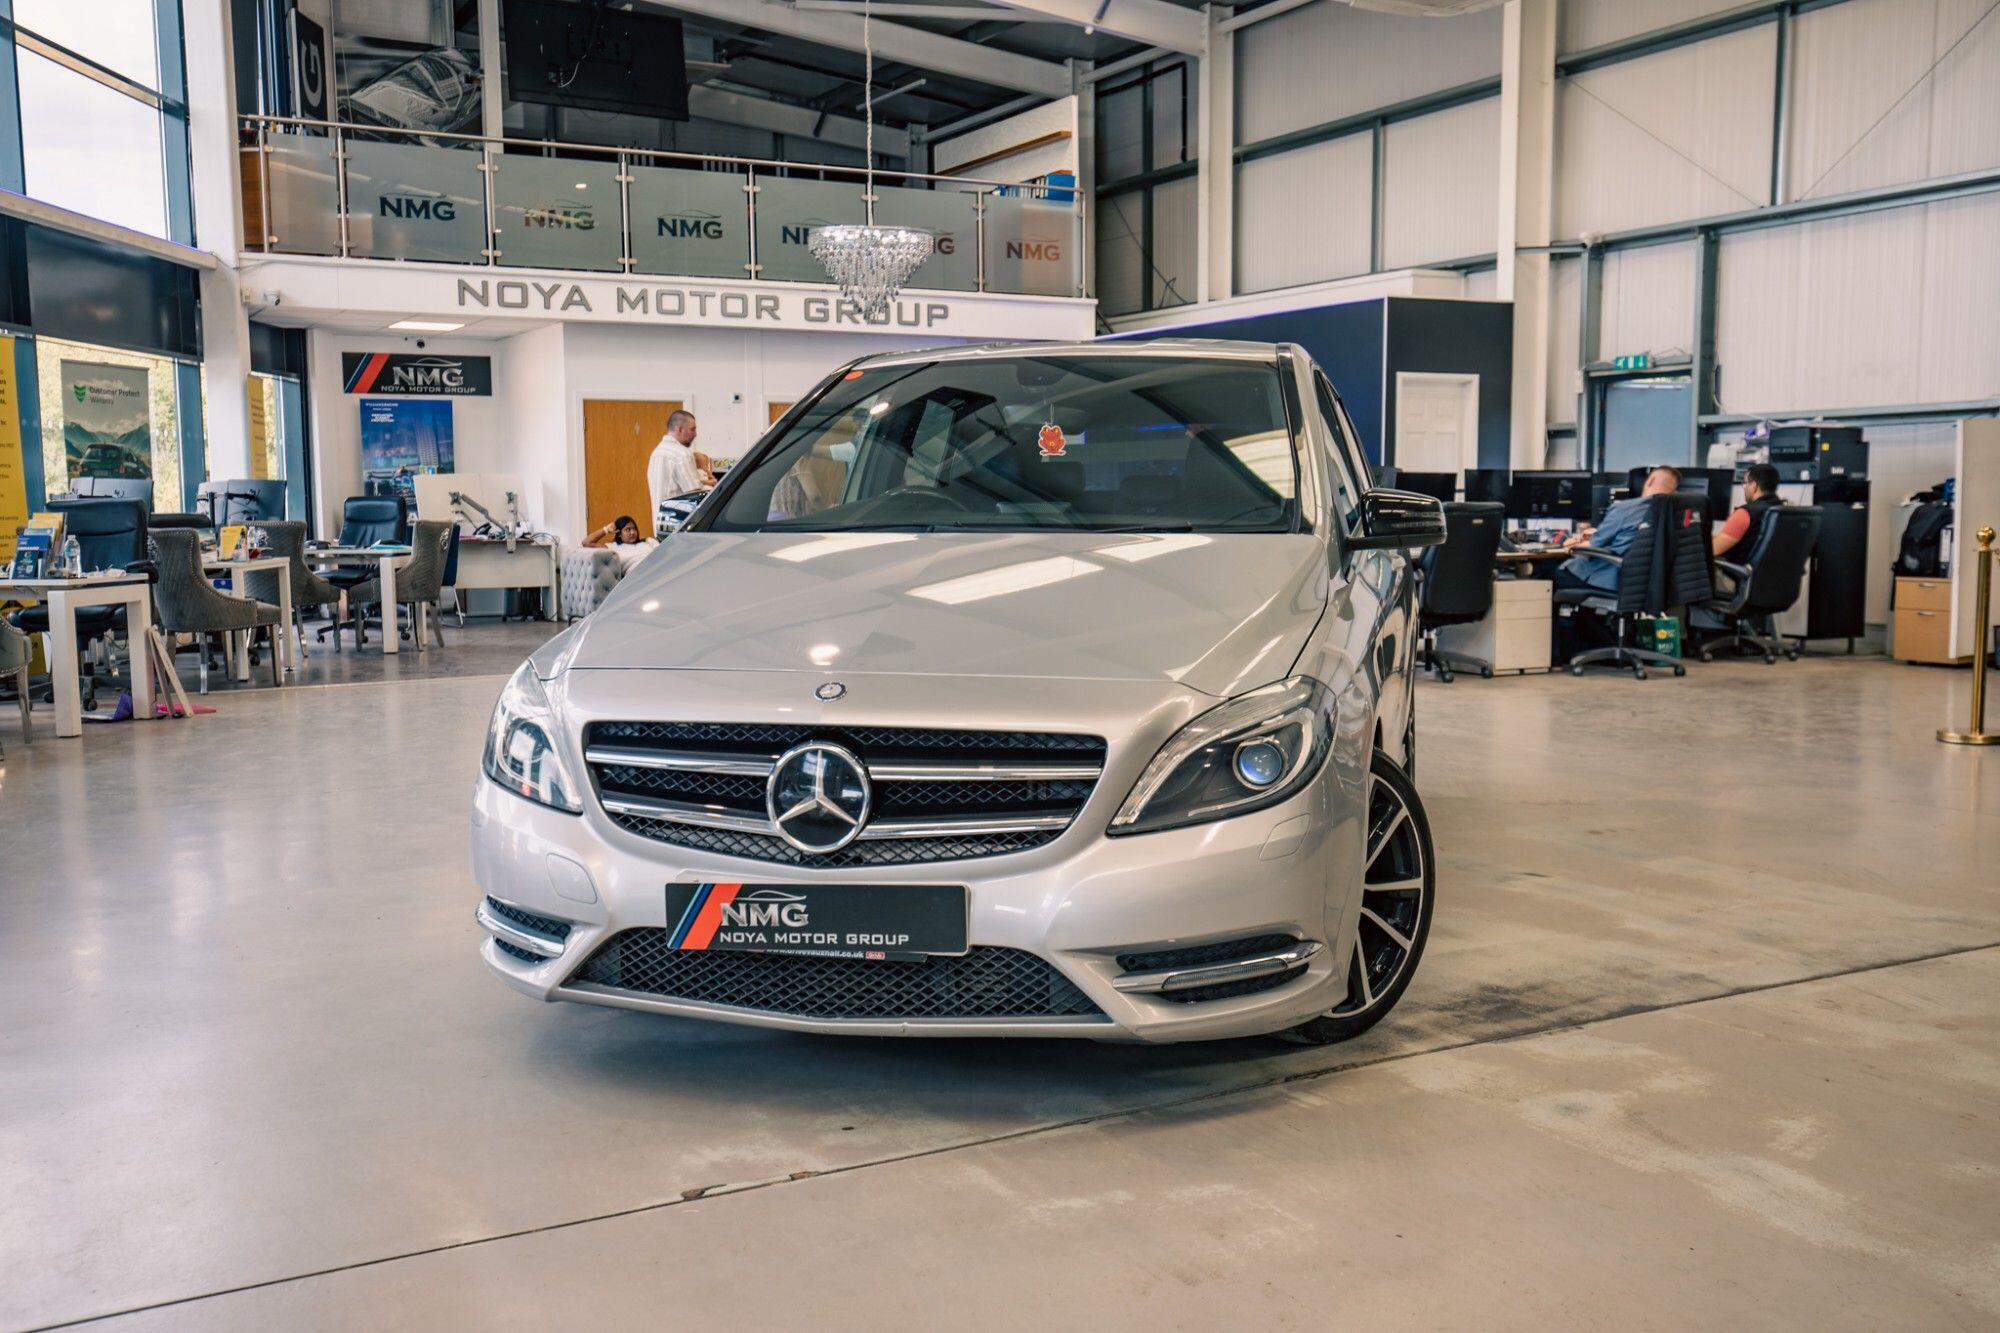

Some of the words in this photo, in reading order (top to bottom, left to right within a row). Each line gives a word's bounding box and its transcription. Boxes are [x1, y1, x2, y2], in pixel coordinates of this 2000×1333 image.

[379, 196, 456, 221] NMG
[524, 208, 595, 230] NMG
[657, 217, 723, 239] NMG
[1006, 241, 1060, 261] NMG
[457, 279, 593, 312] NOYA
[616, 286, 781, 320] MOTOR
[392, 366, 464, 387] NMG
[89, 386, 117, 396] Customer
[118, 388, 140, 398] Protect
[409, 385, 441, 393] MOTOR
[445, 386, 476, 394] GROUP
[720, 902, 809, 928] NMG
[720, 932, 768, 944] NOYA
[775, 932, 838, 945] MOTOR
[846, 933, 910, 946] GROUP
